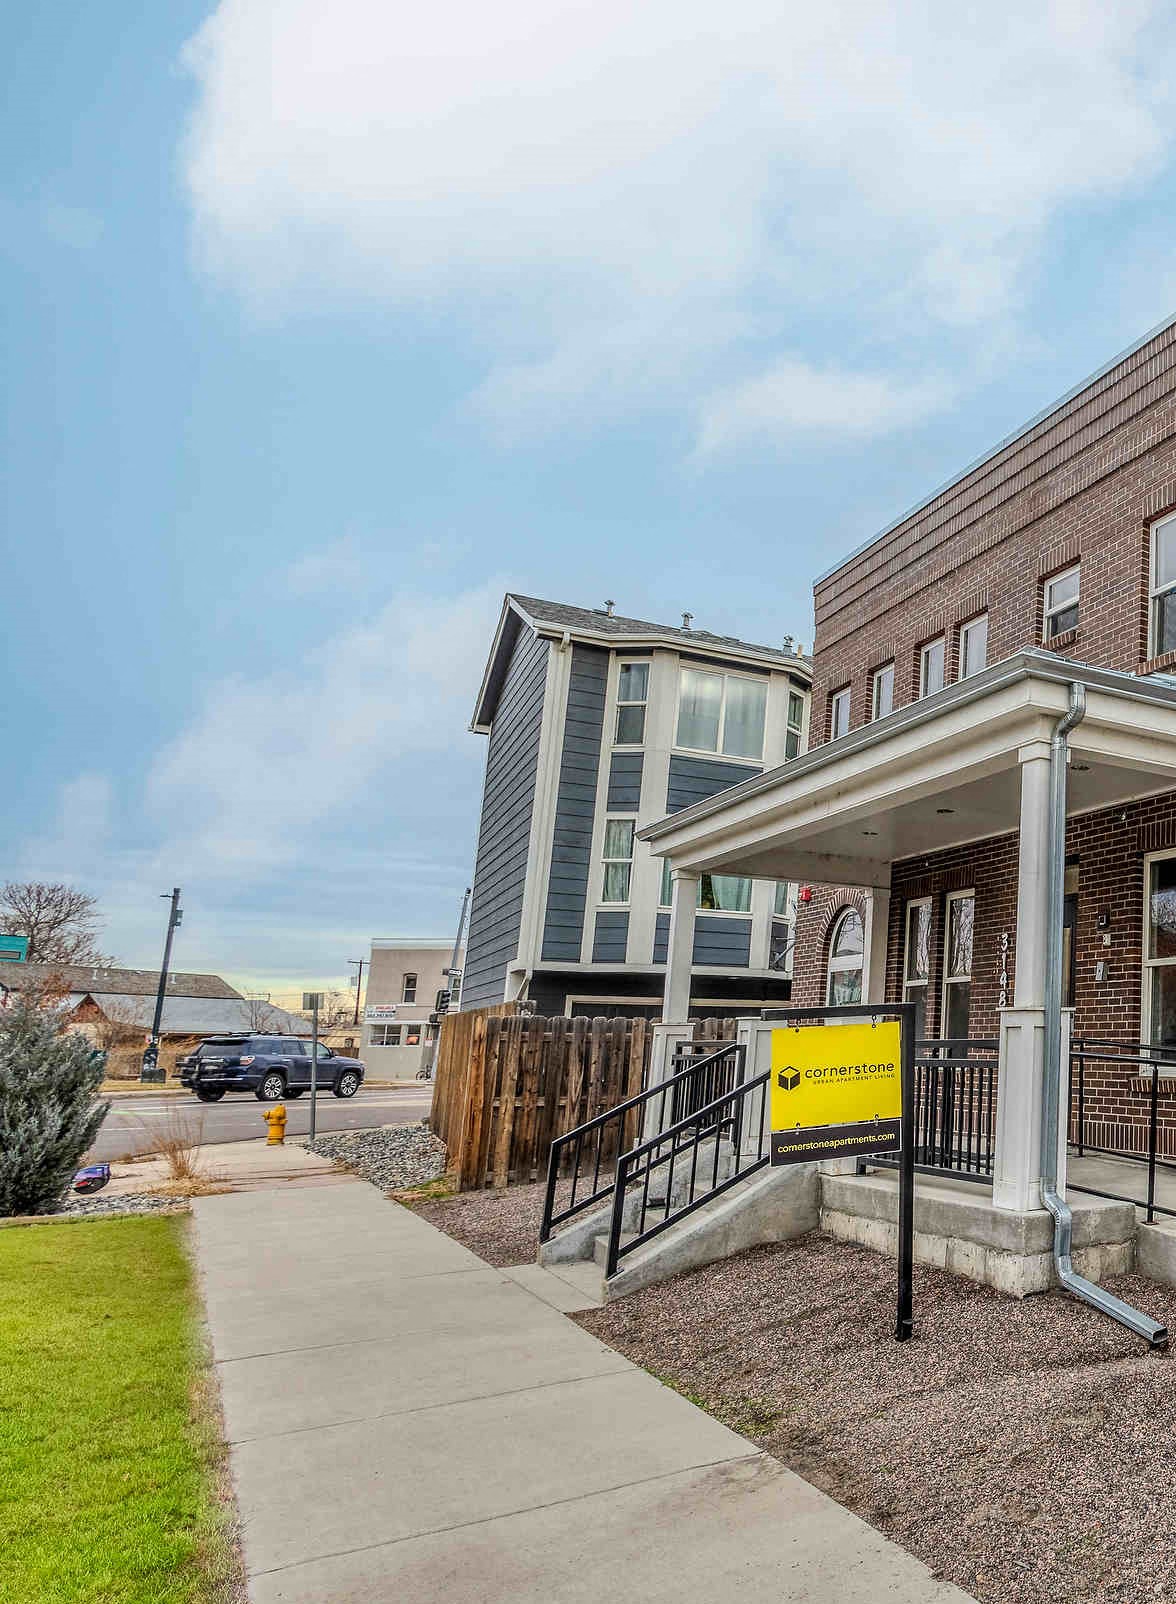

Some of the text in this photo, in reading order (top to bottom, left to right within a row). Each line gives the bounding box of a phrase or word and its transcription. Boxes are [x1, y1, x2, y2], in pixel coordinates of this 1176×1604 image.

[999, 933, 1009, 1007] 3148
[805, 1062, 895, 1079] cornerstone
[836, 1075, 873, 1084] APARTMENT
[874, 1072, 896, 1080] LIVING
[777, 1132, 896, 1153] cornerstoneapartments.com
